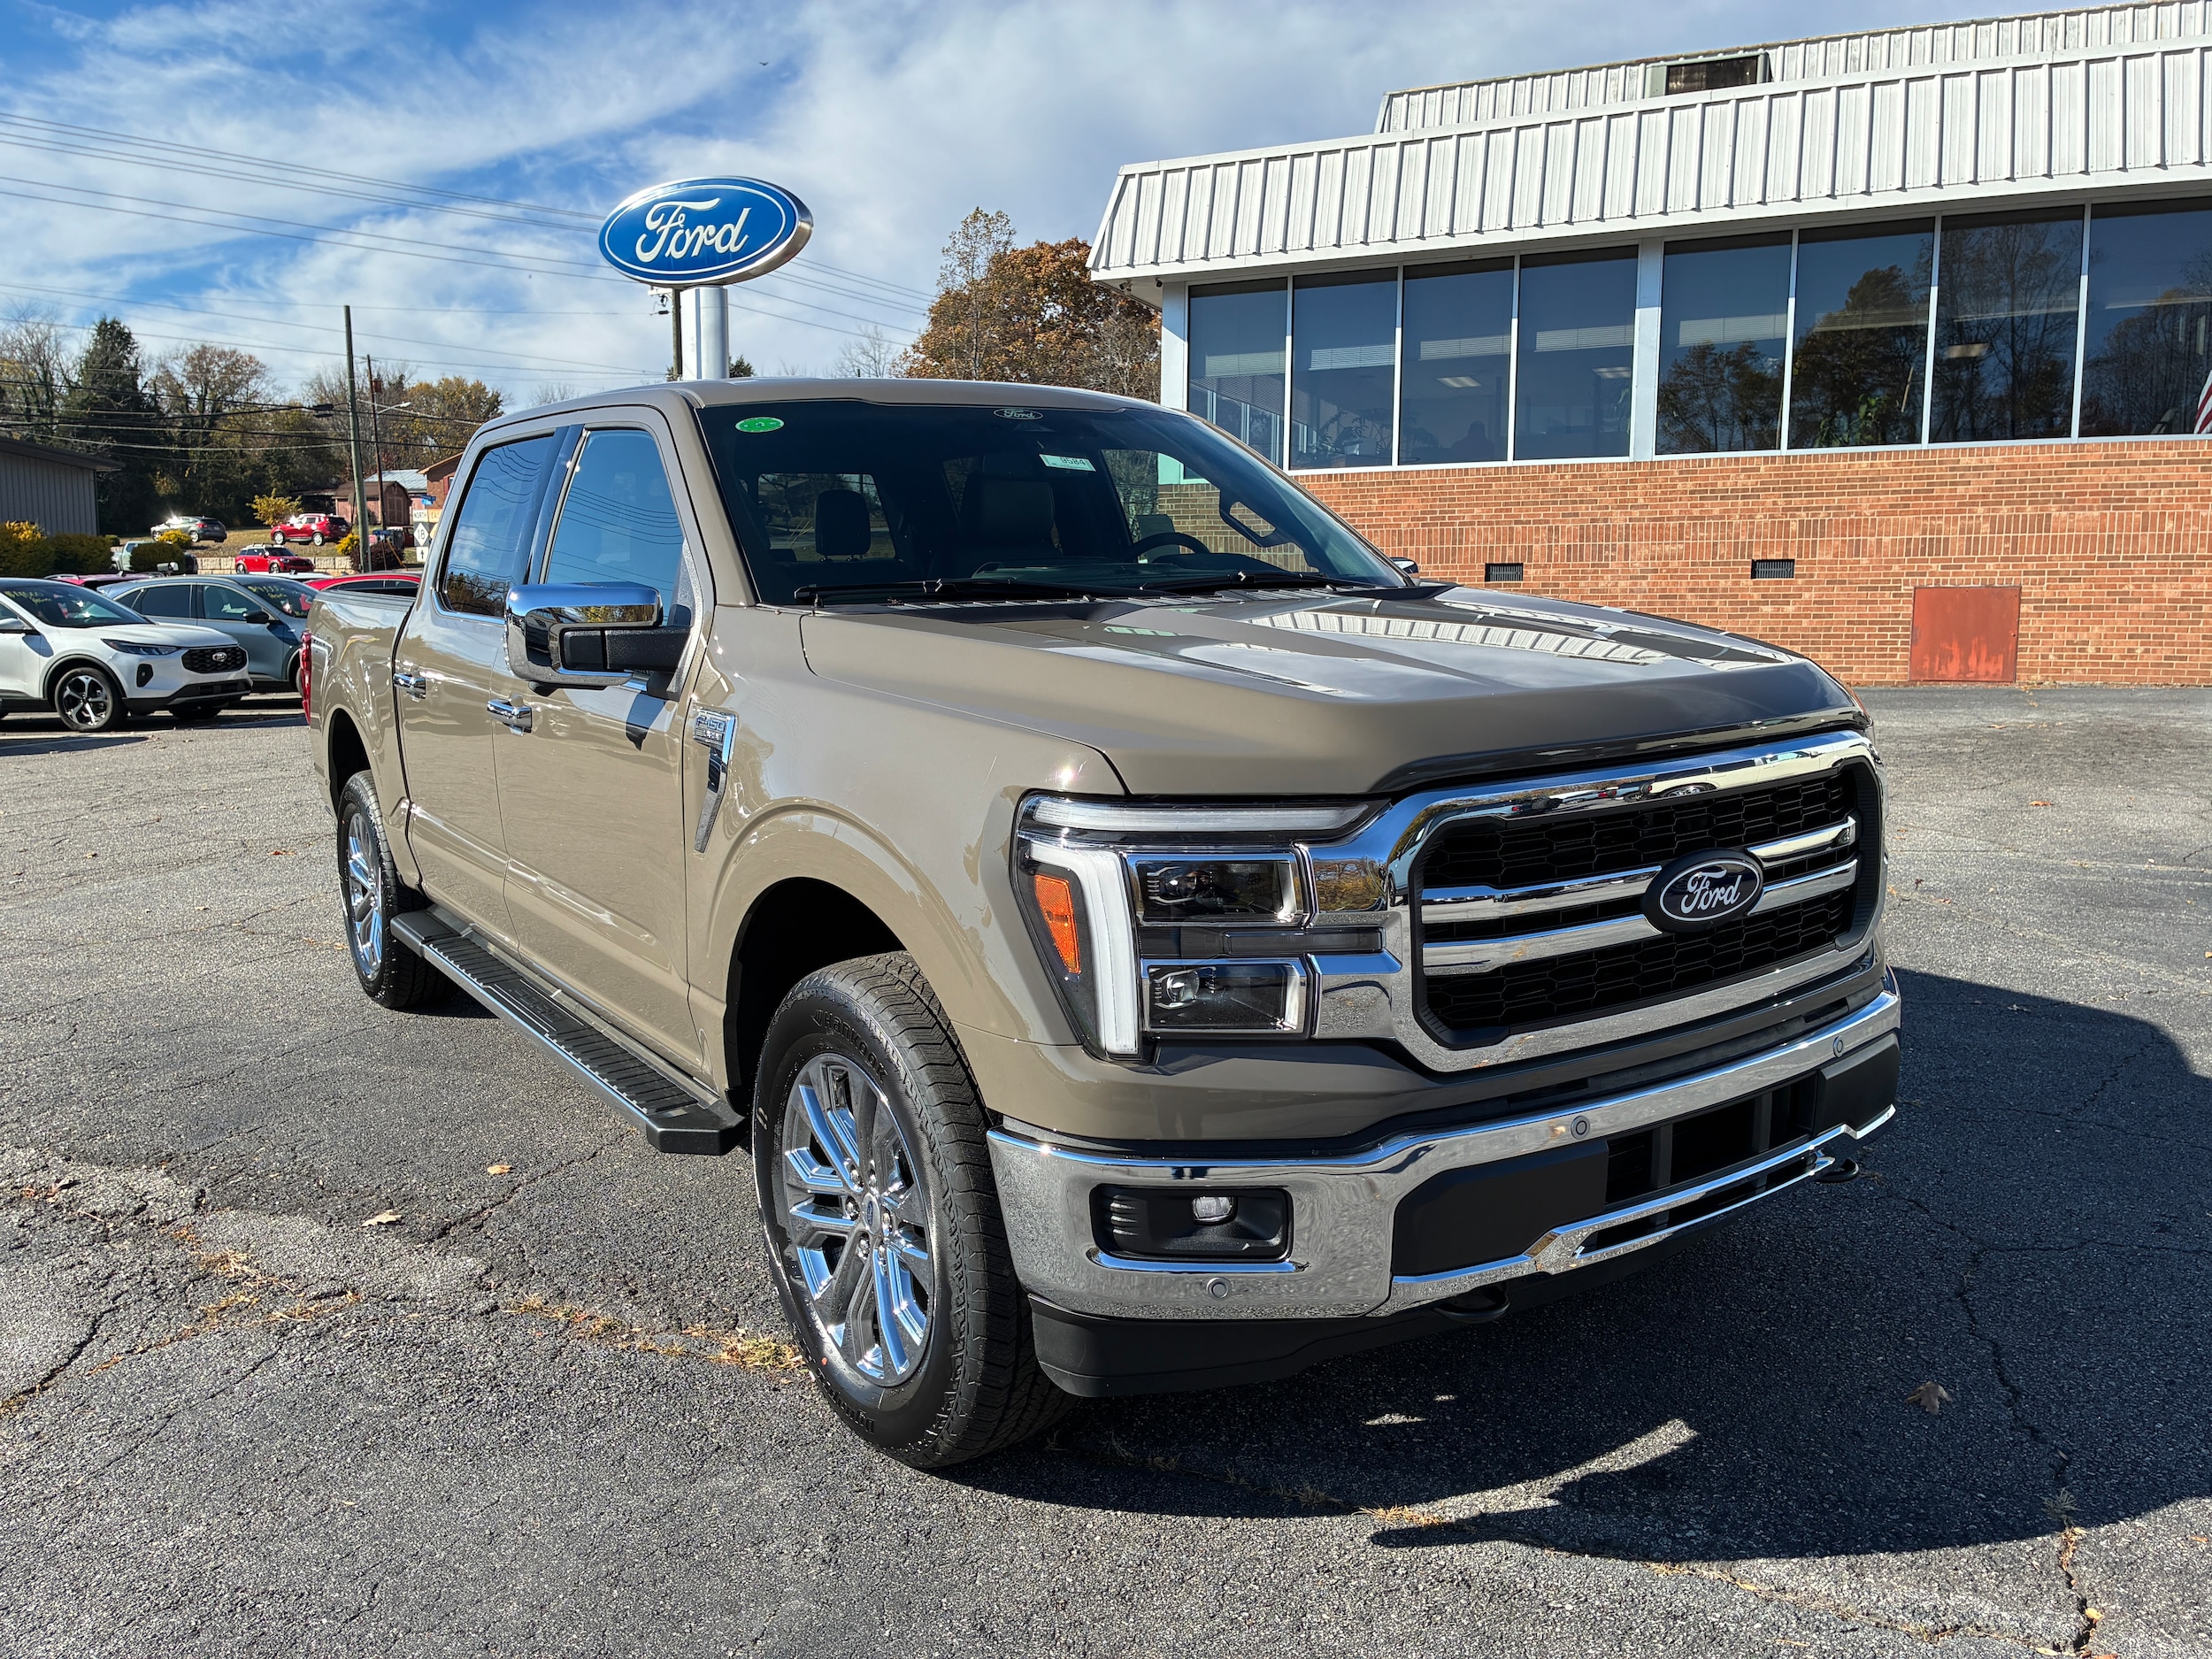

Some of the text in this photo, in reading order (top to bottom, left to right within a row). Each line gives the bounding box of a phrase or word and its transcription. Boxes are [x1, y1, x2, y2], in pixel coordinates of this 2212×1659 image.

[635, 197, 751, 262] Ford
[1003, 409, 1035, 418] Ford
[417, 529, 426, 540] 18
[1681, 869, 1742, 914] Ford
